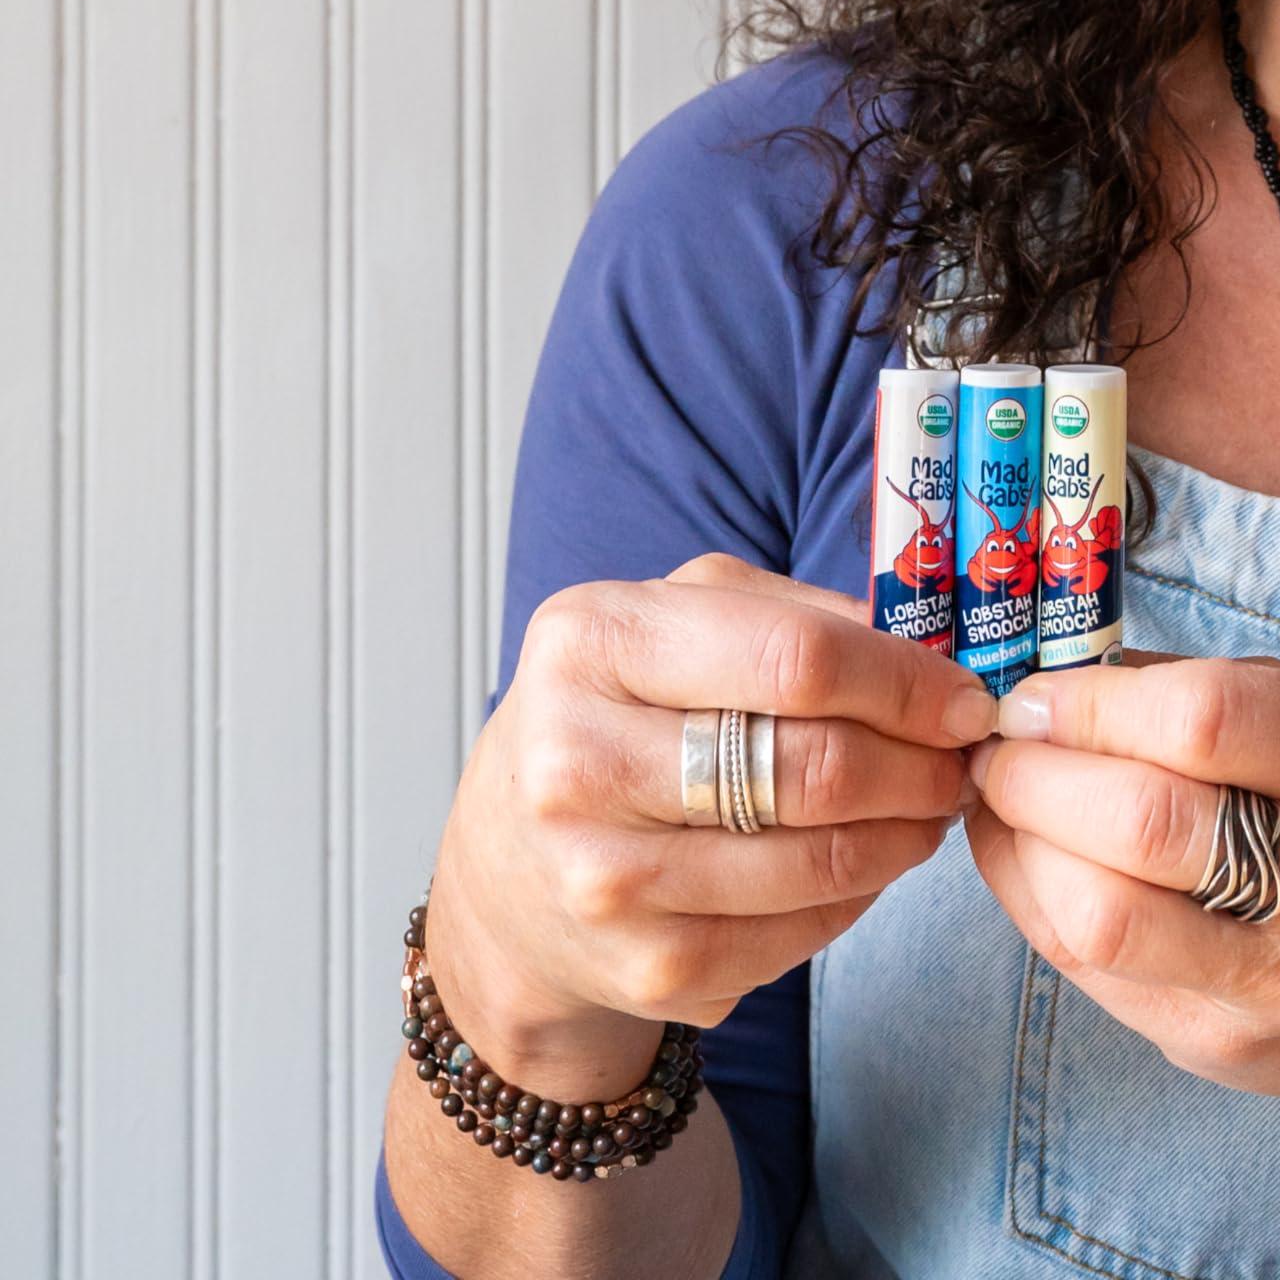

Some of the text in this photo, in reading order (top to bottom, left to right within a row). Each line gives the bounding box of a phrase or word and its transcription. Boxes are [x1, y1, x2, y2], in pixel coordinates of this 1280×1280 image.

[996, 408, 1018, 418] USDA
[1059, 405, 1080, 415] USDA
[911, 454, 953, 479] Mad
[981, 457, 1028, 484] Mad
[1048, 453, 1089, 477] Mad
[1047, 475, 1090, 499] Gab's
[962, 593, 1033, 626] LOBSTAH
[1041, 592, 1099, 618] OBSTAH
[968, 637, 1032, 669] blueberry
[1042, 637, 1089, 663] vanilla
